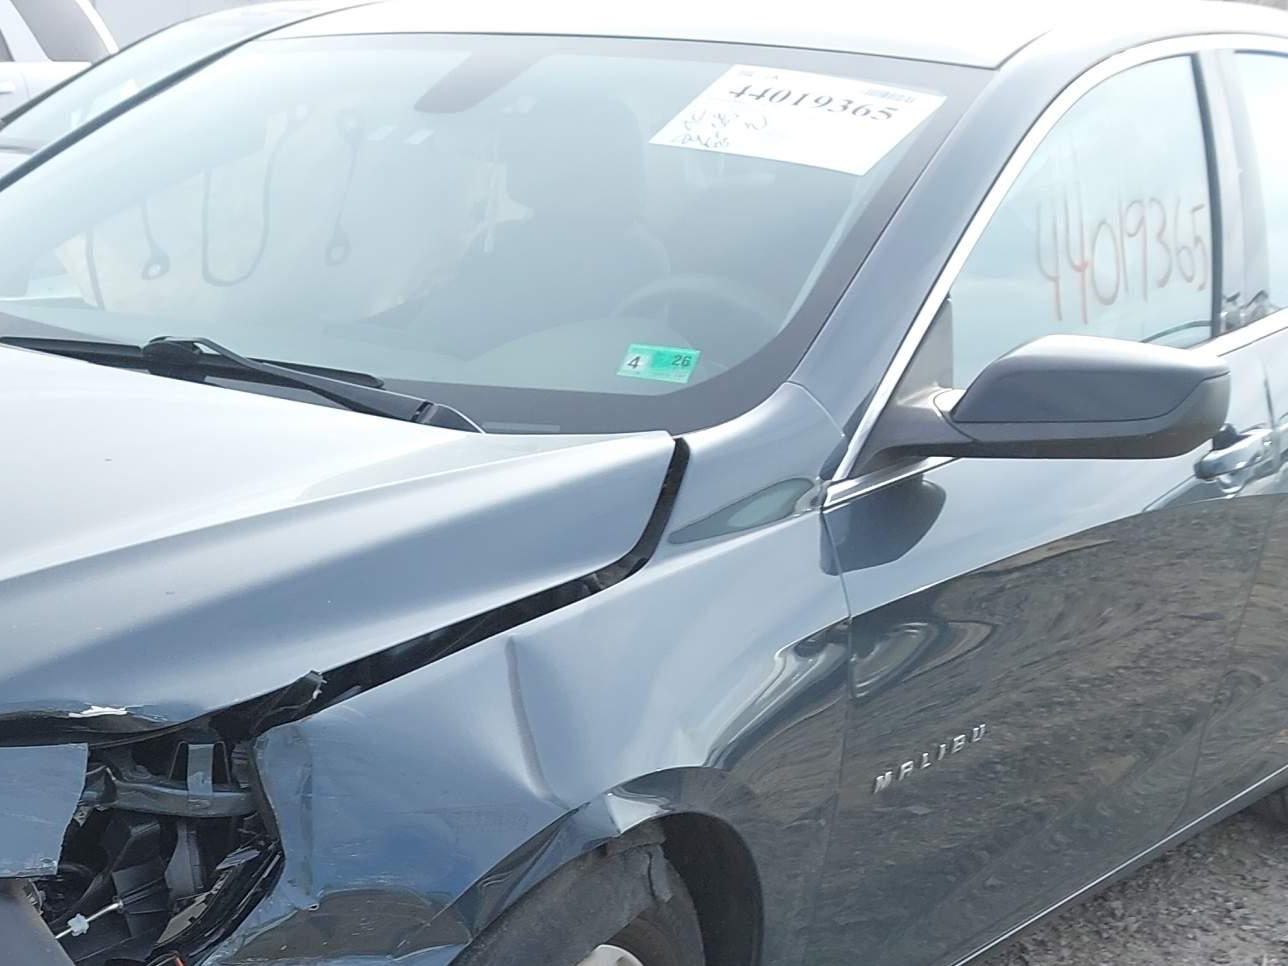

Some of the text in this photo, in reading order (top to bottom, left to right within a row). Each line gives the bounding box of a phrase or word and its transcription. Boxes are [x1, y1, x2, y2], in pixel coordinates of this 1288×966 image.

[727, 84, 900, 121] 44019365
[1037, 188, 1208, 324] 44019365
[628, 356, 640, 368] 4
[874, 724, 986, 793] MALIBU
